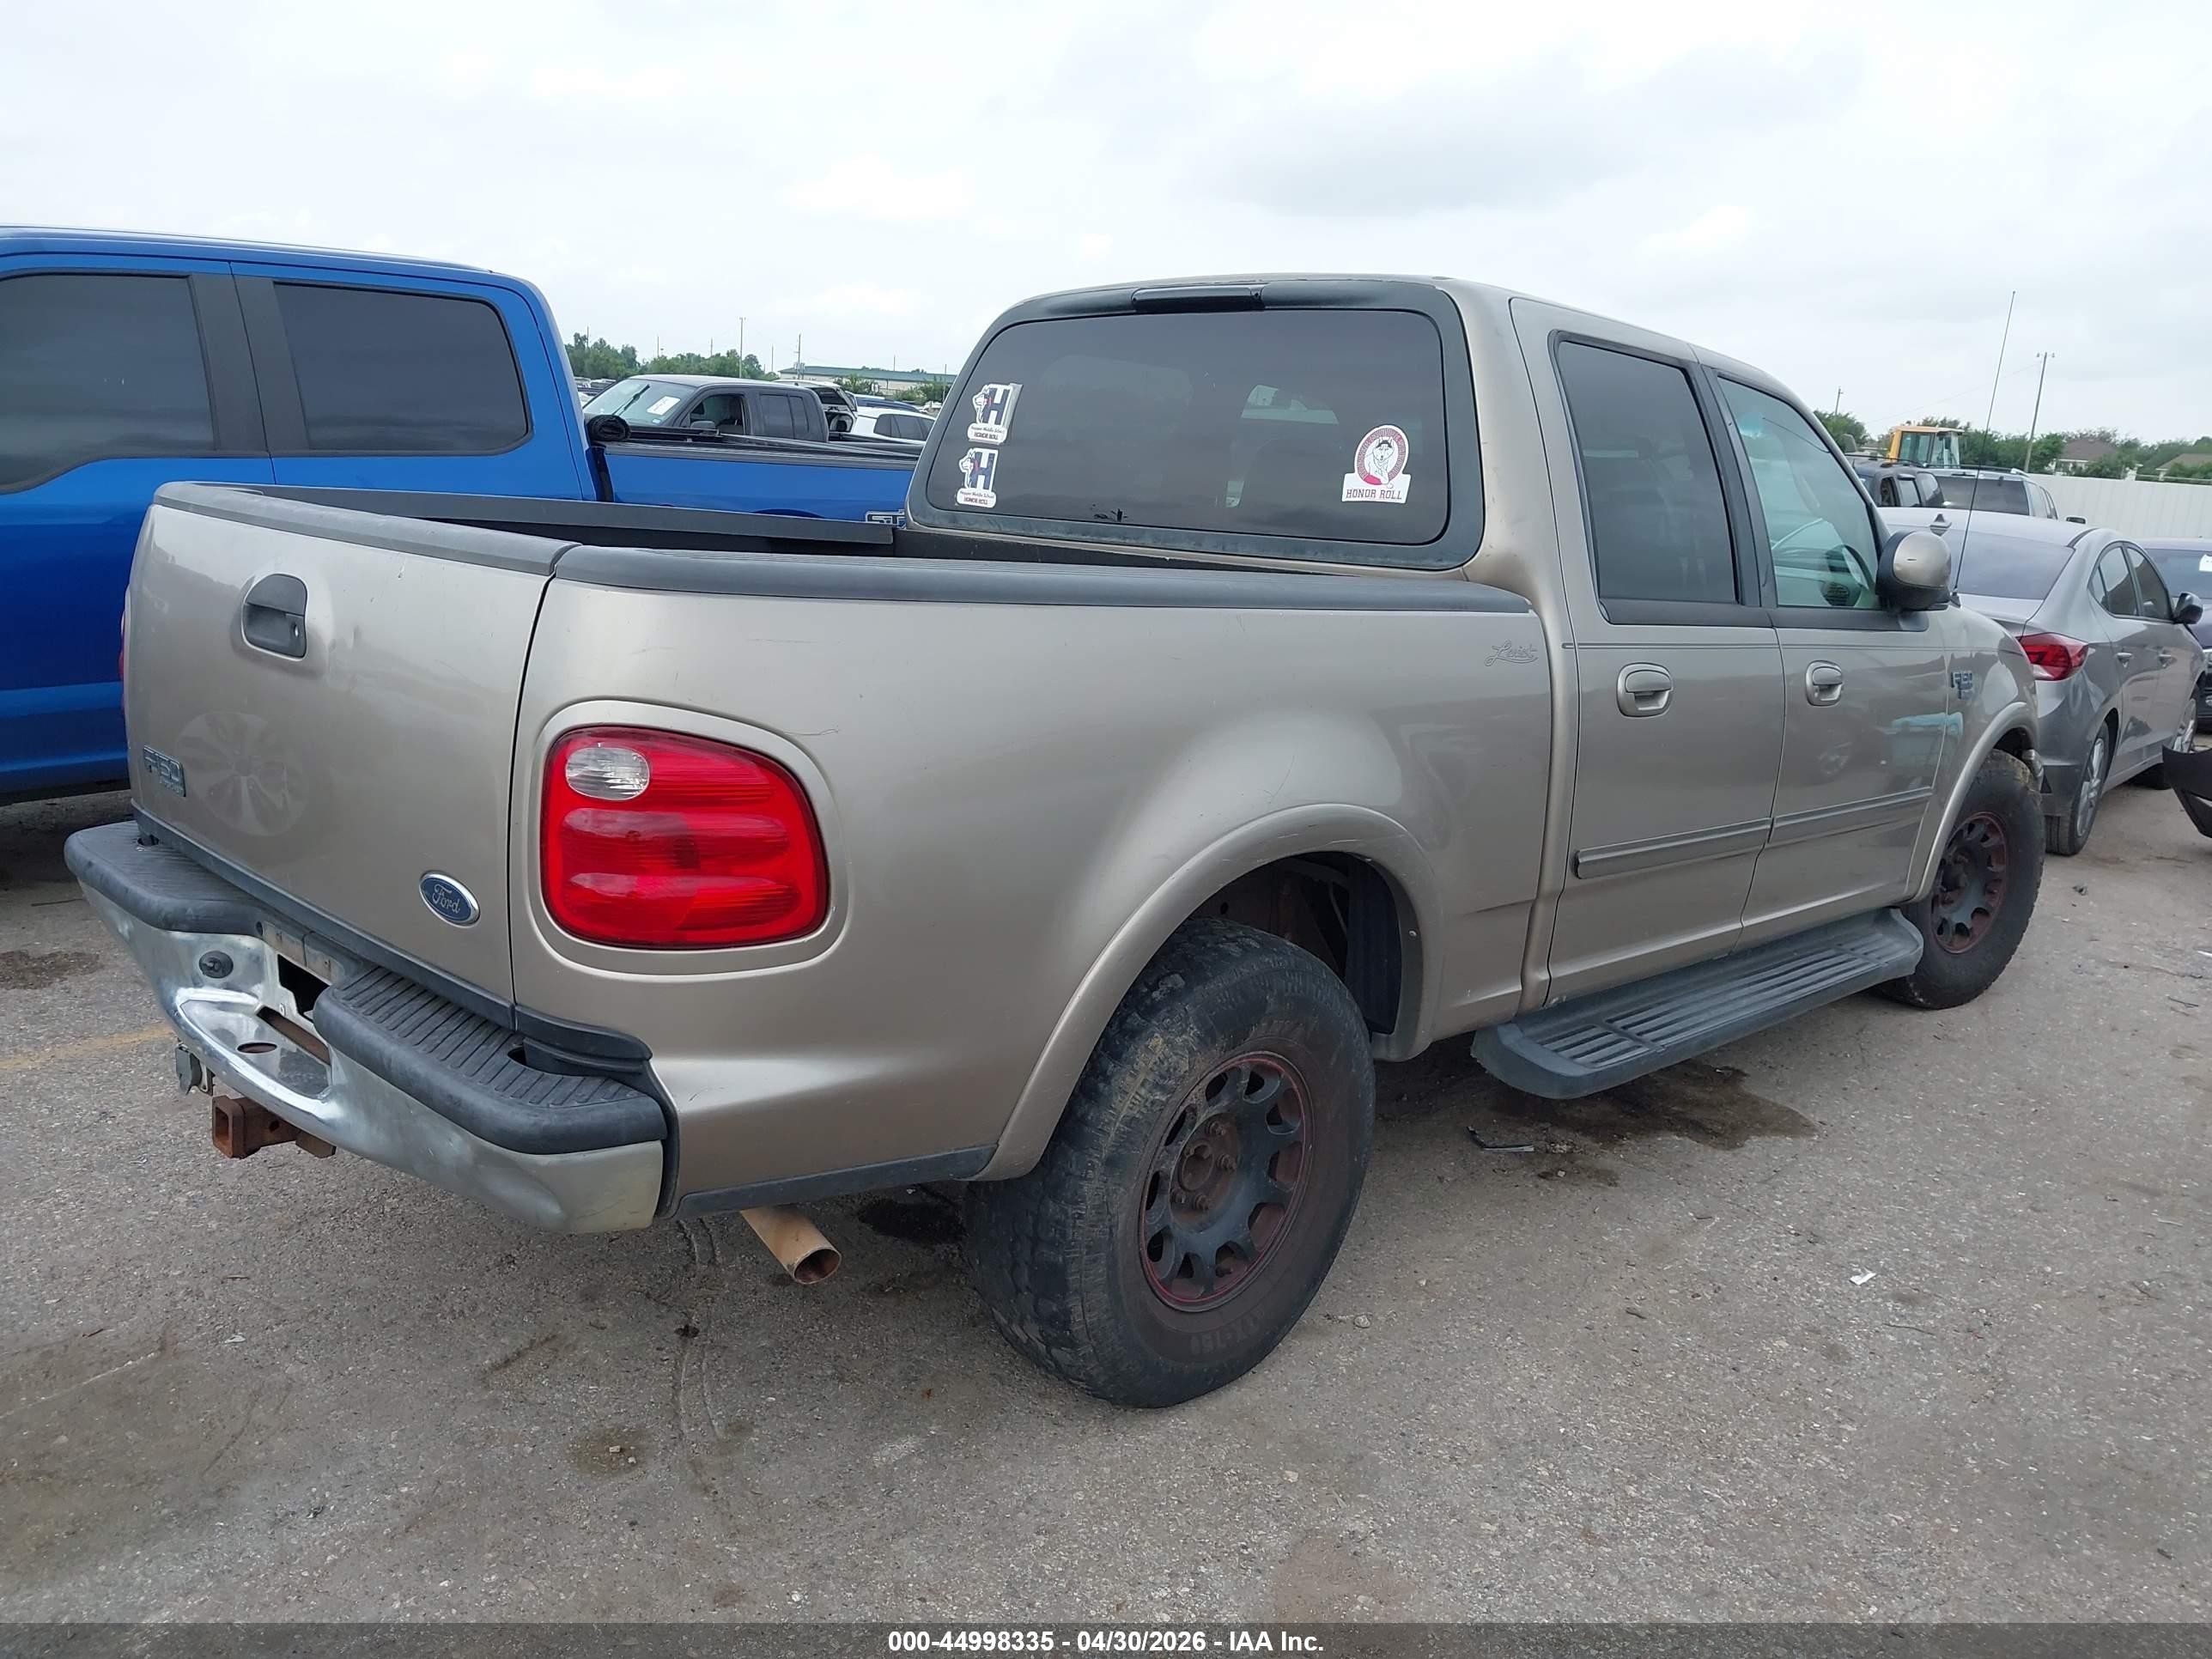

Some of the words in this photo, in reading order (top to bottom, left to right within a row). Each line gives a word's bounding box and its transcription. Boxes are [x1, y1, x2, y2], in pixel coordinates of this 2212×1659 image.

[1346, 489, 1376, 499] HONOR
[1379, 489, 1402, 500] ROLL
[432, 884, 461, 915] Ford
